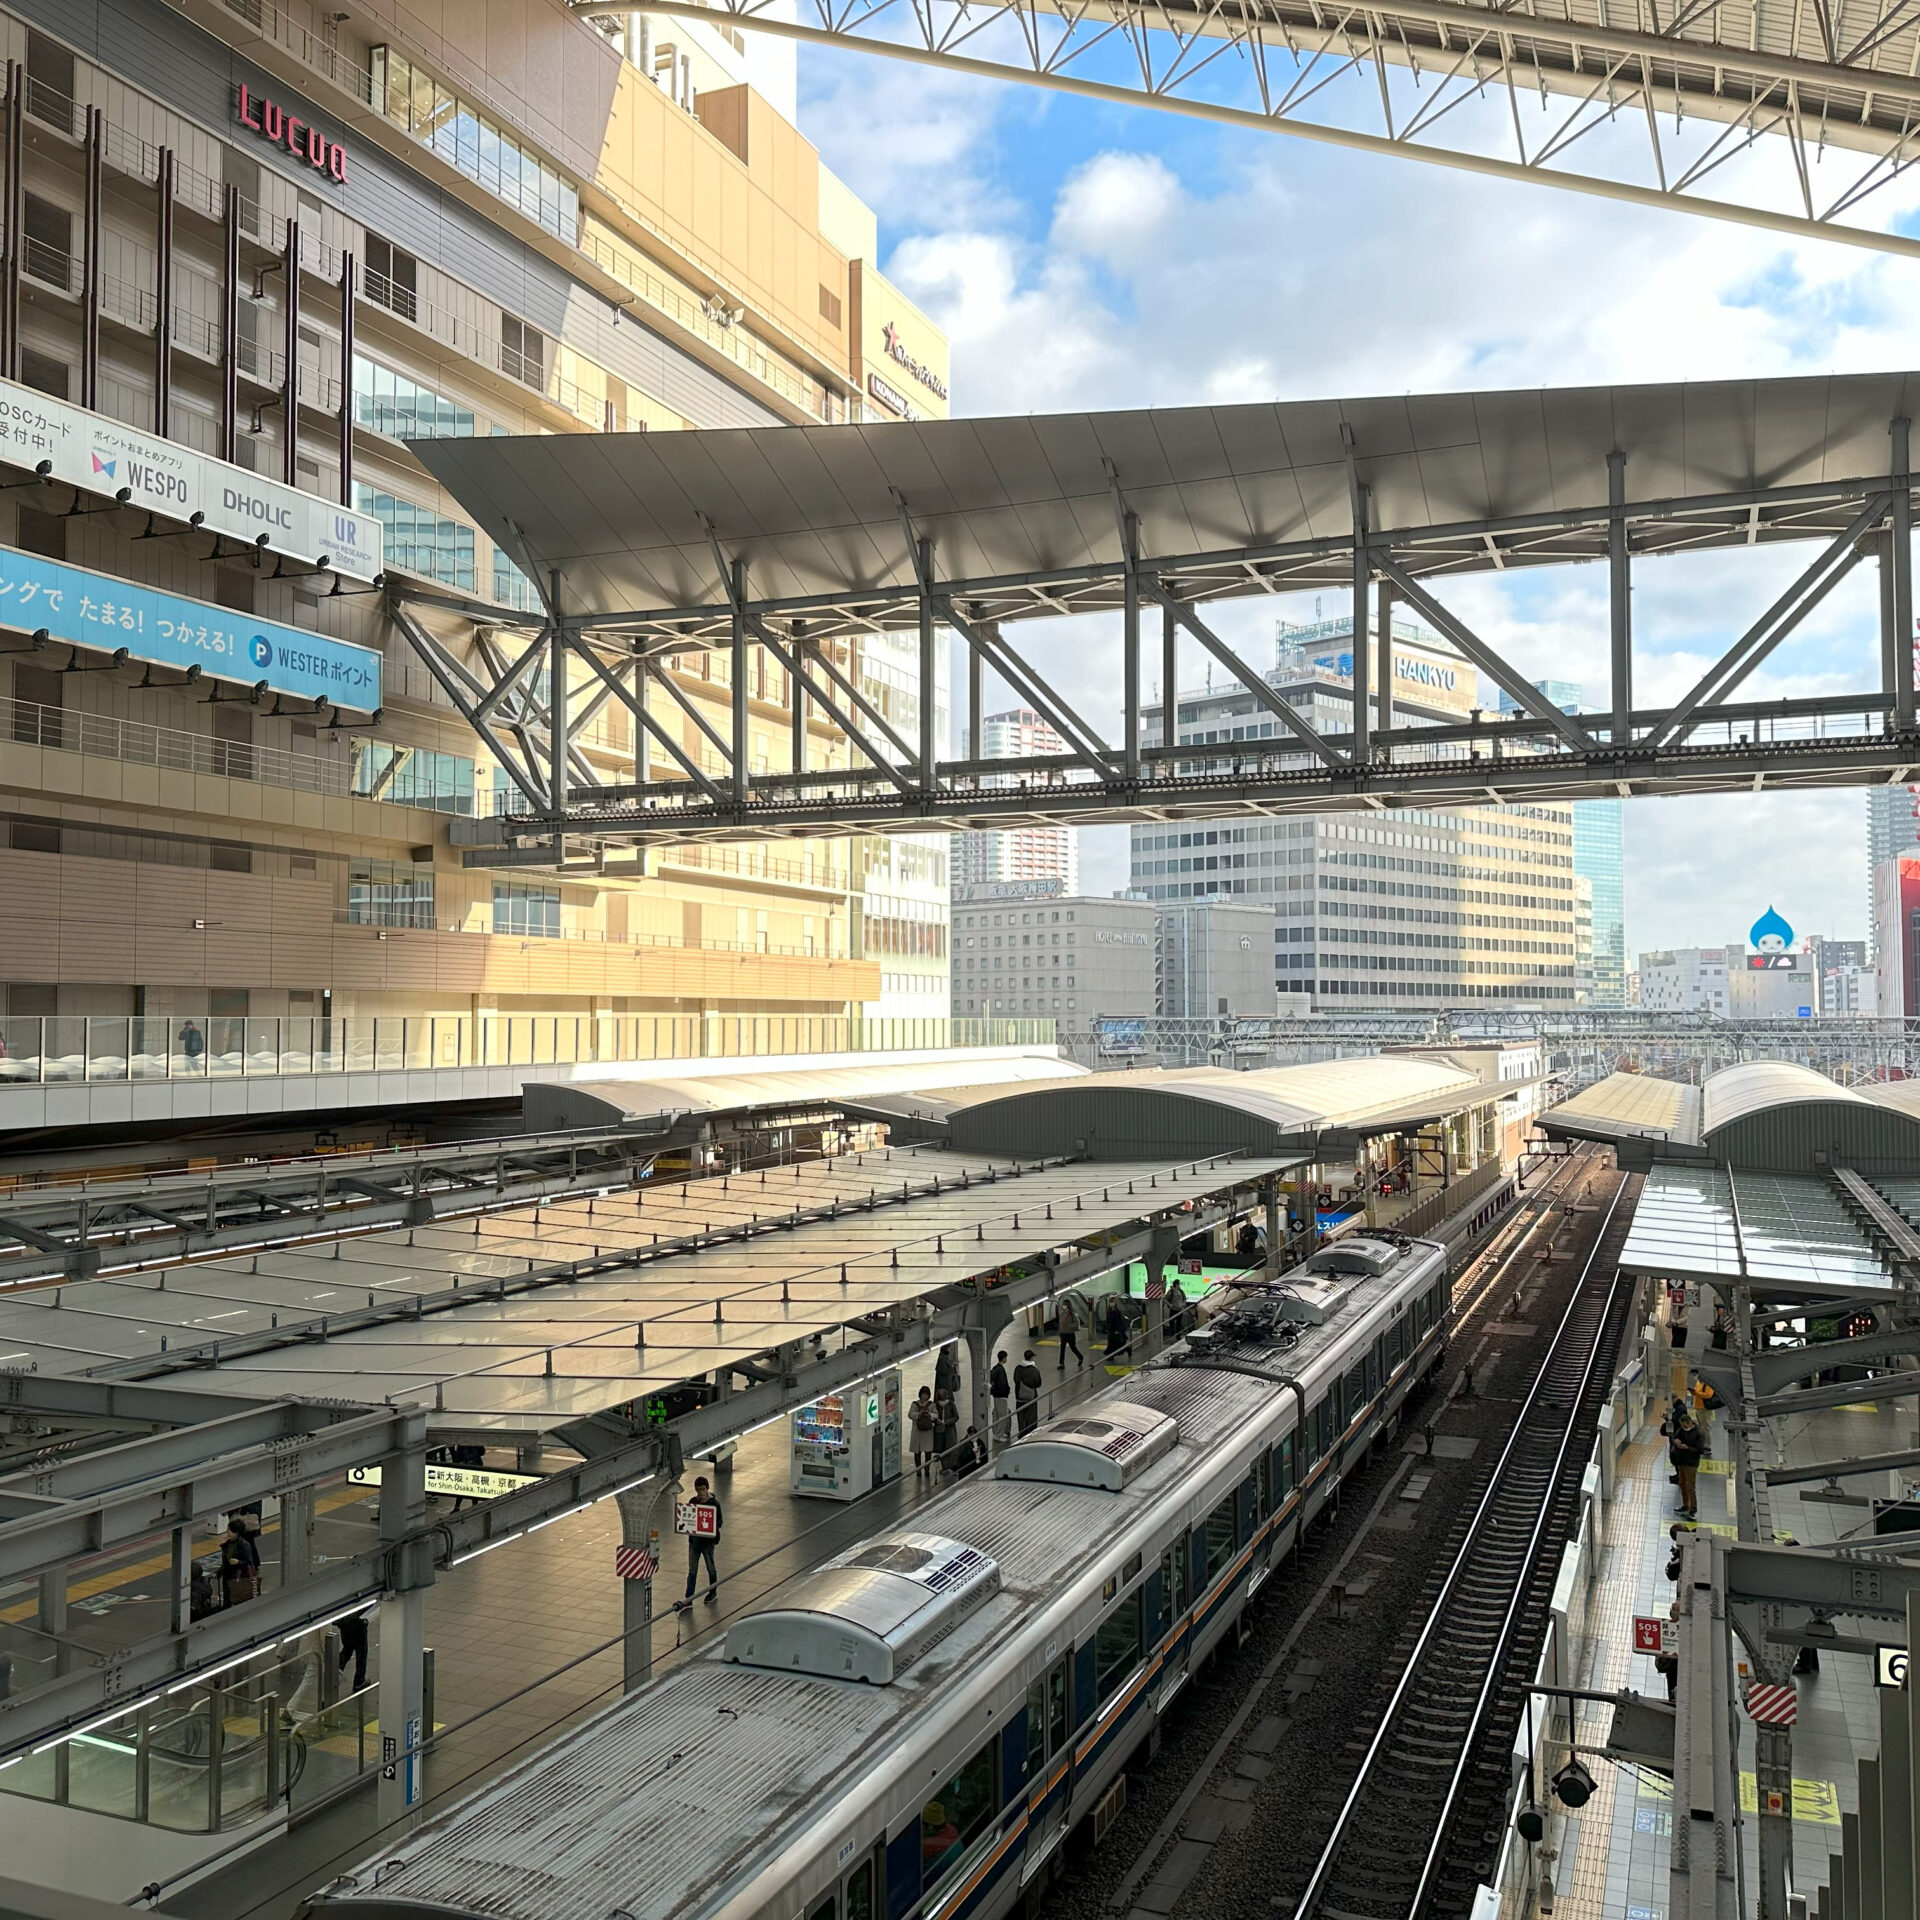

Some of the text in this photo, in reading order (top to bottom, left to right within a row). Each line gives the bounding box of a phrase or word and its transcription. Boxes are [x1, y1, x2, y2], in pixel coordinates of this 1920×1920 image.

[94, 430, 183, 470] ポイントおまとめアプリ
[127, 460, 187, 503] WESPO
[223, 487, 292, 530] DHOLIC
[334, 515, 357, 546] UR
[319, 537, 372, 562] URBAN RESEARCH
[335, 551, 356, 566] Store
[278, 646, 329, 679] WESTER
[330, 661, 373, 688] ポイント
[1395, 656, 1455, 691] HANKYU
[428, 1481, 437, 1489] for
[1638, 1623, 1658, 1632] SOS
[1888, 1653, 1908, 1682] 6
